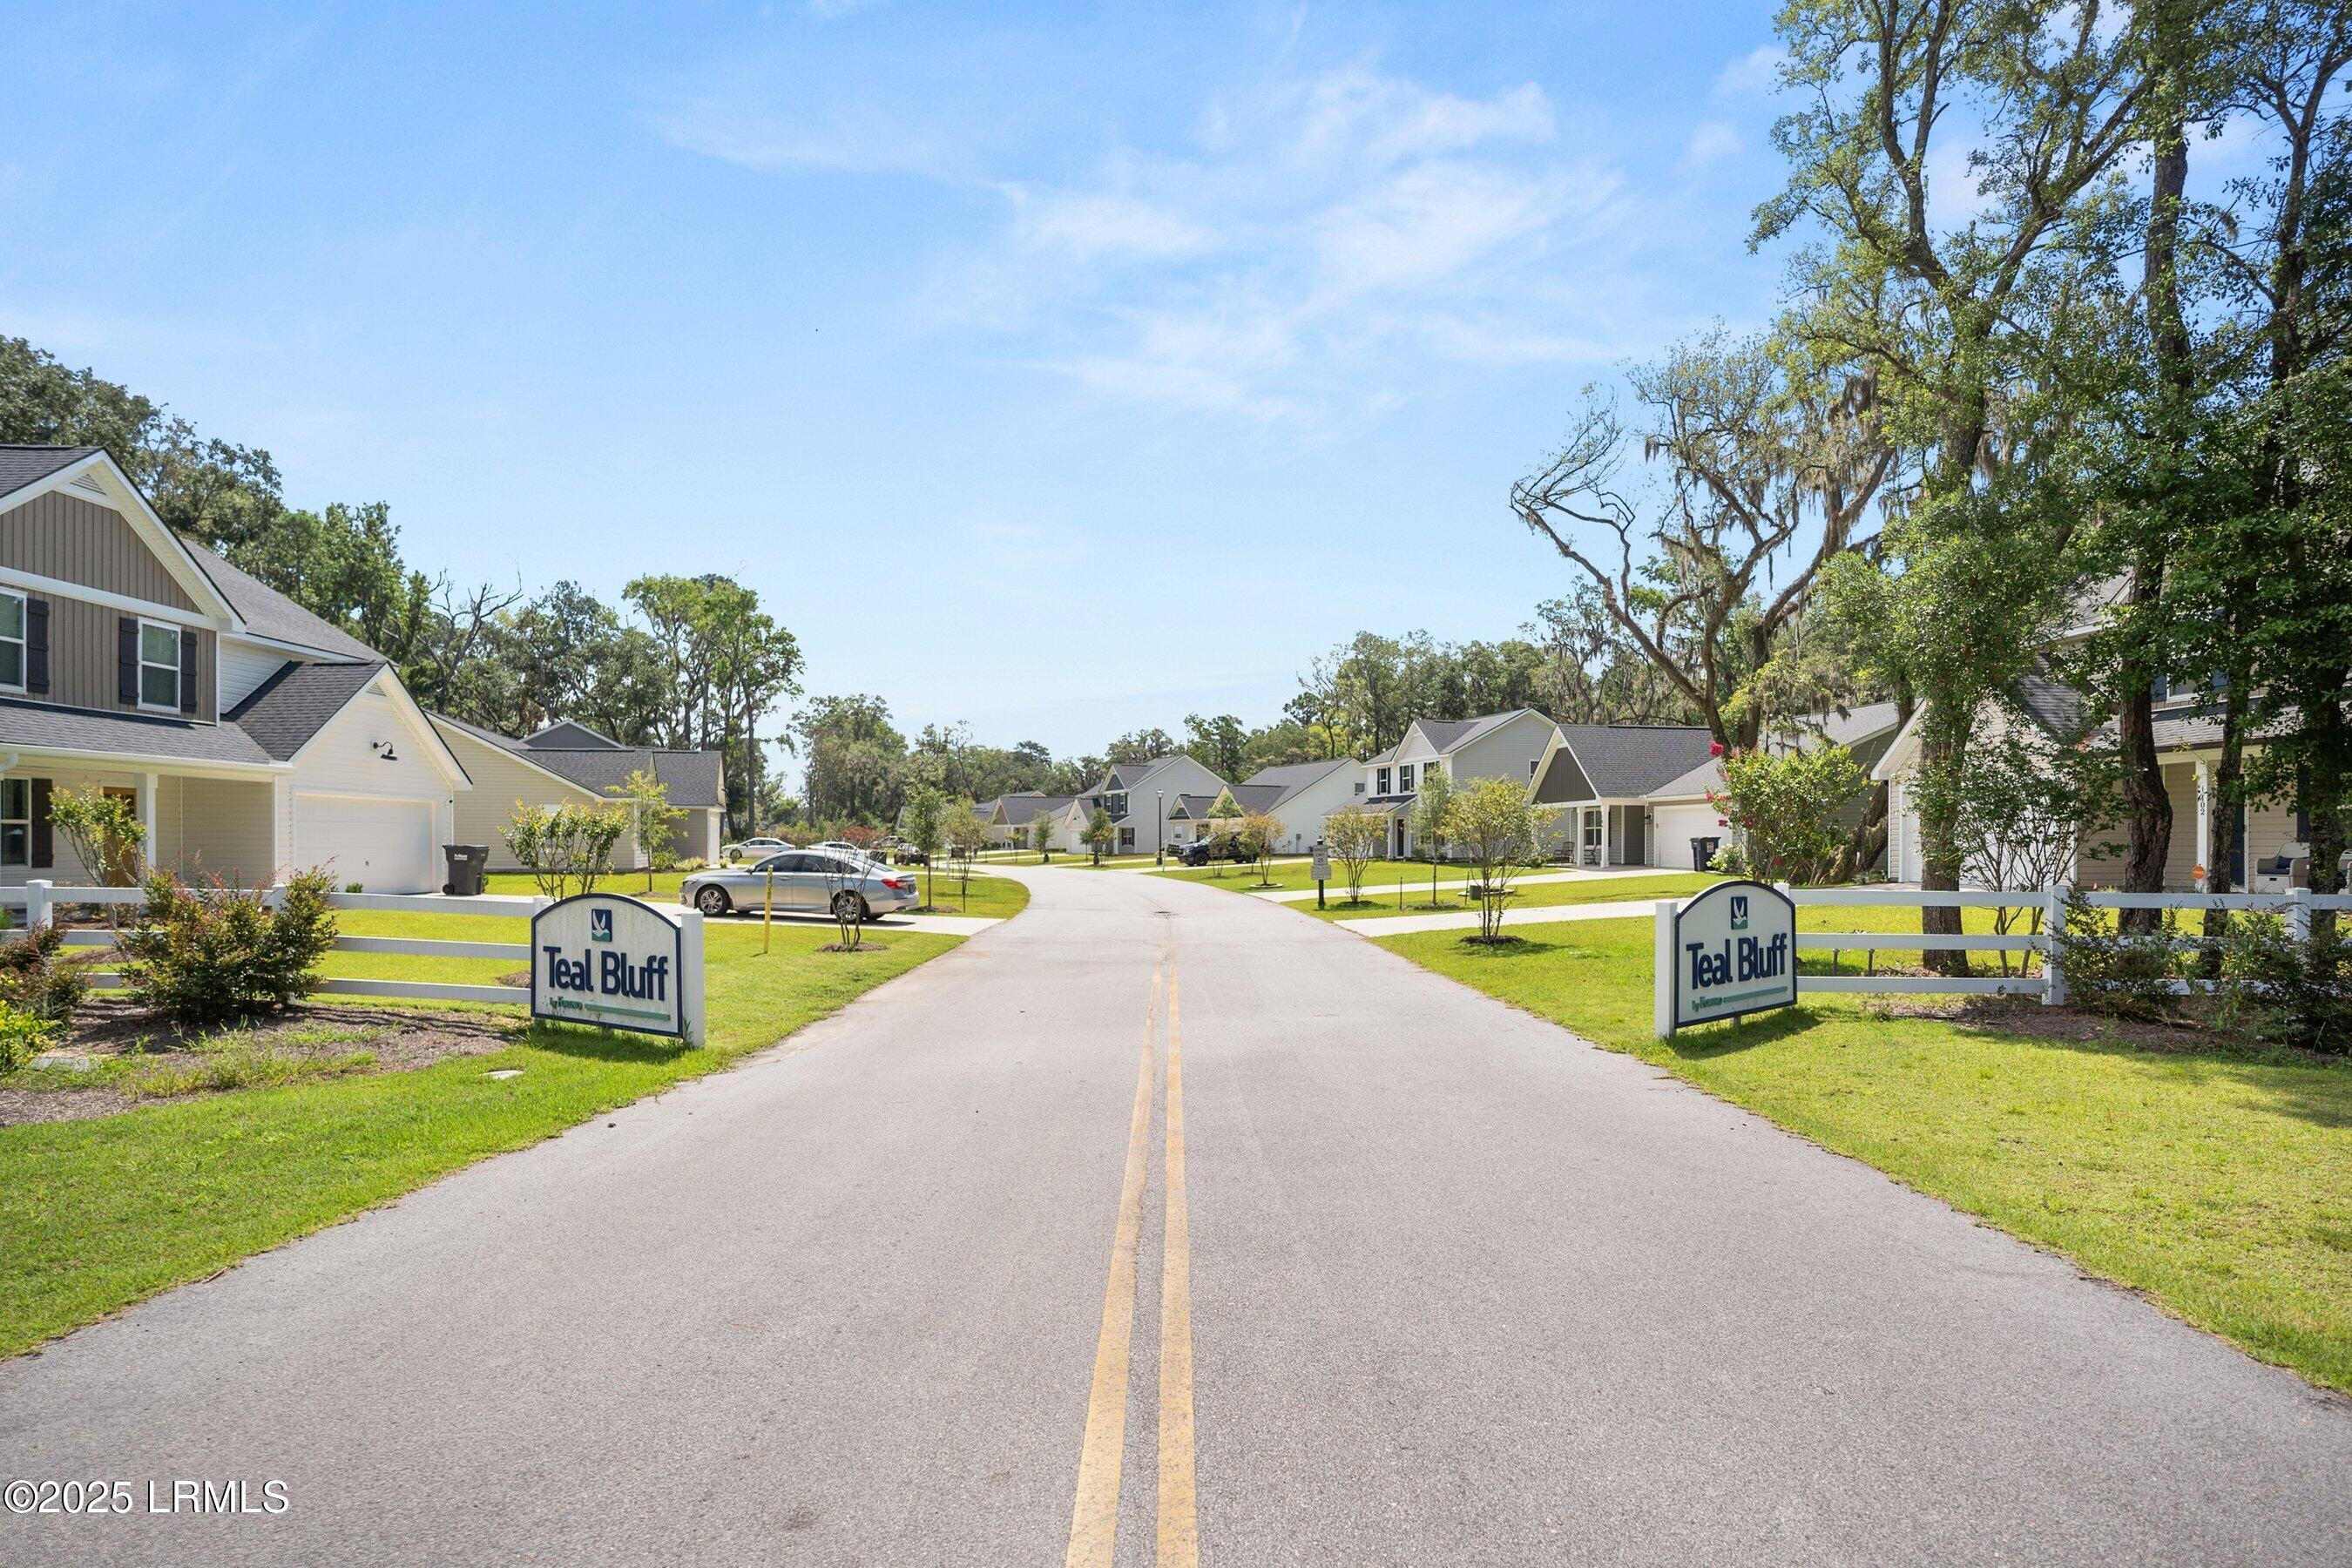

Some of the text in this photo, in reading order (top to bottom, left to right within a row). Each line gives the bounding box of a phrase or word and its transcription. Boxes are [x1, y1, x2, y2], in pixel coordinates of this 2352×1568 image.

[543, 946, 668, 1001] Teal Bluff
[1686, 933, 1788, 990] Teal Bluff
